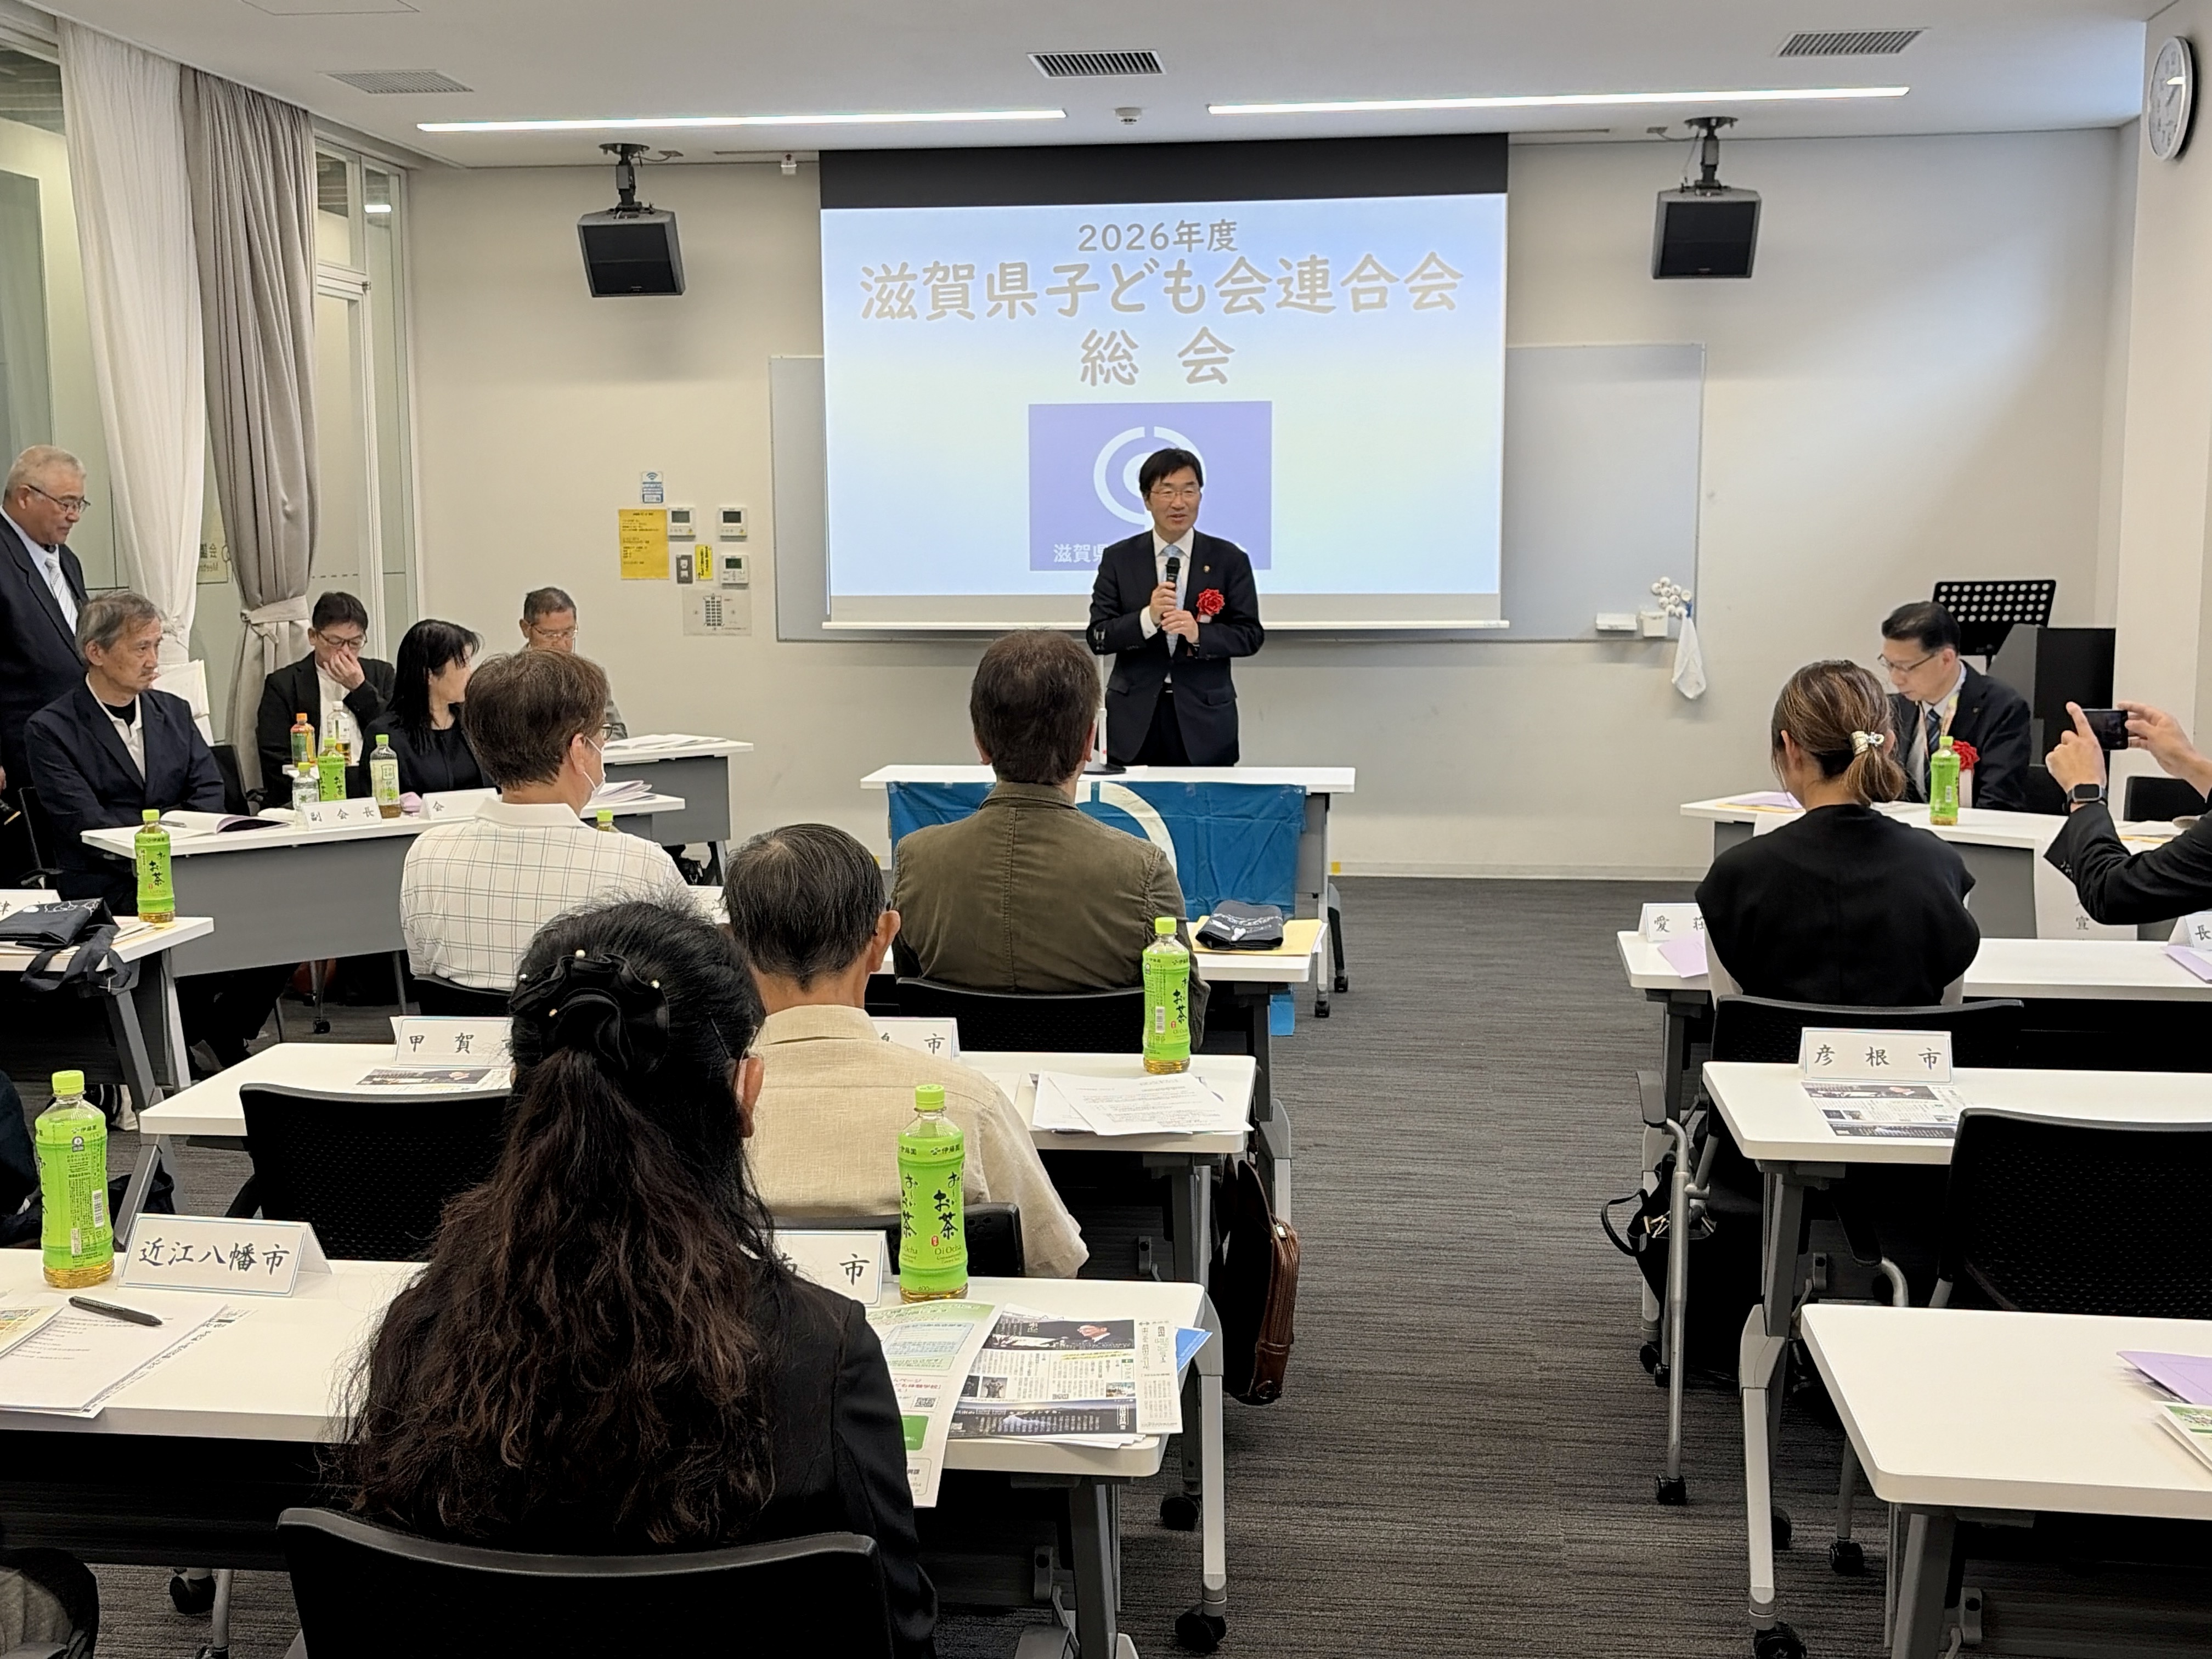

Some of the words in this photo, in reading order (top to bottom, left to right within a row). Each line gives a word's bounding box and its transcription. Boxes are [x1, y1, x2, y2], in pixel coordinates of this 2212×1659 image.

[1077, 219, 1239, 253] 2026年度
[860, 251, 1464, 321] 滋賀県子ども会連合会
[309, 806, 375, 823] 副会長
[1814, 1043, 1942, 1070] 彦根市
[933, 1188, 959, 1240] お茶
[138, 1237, 291, 1276] 近江八幡市
